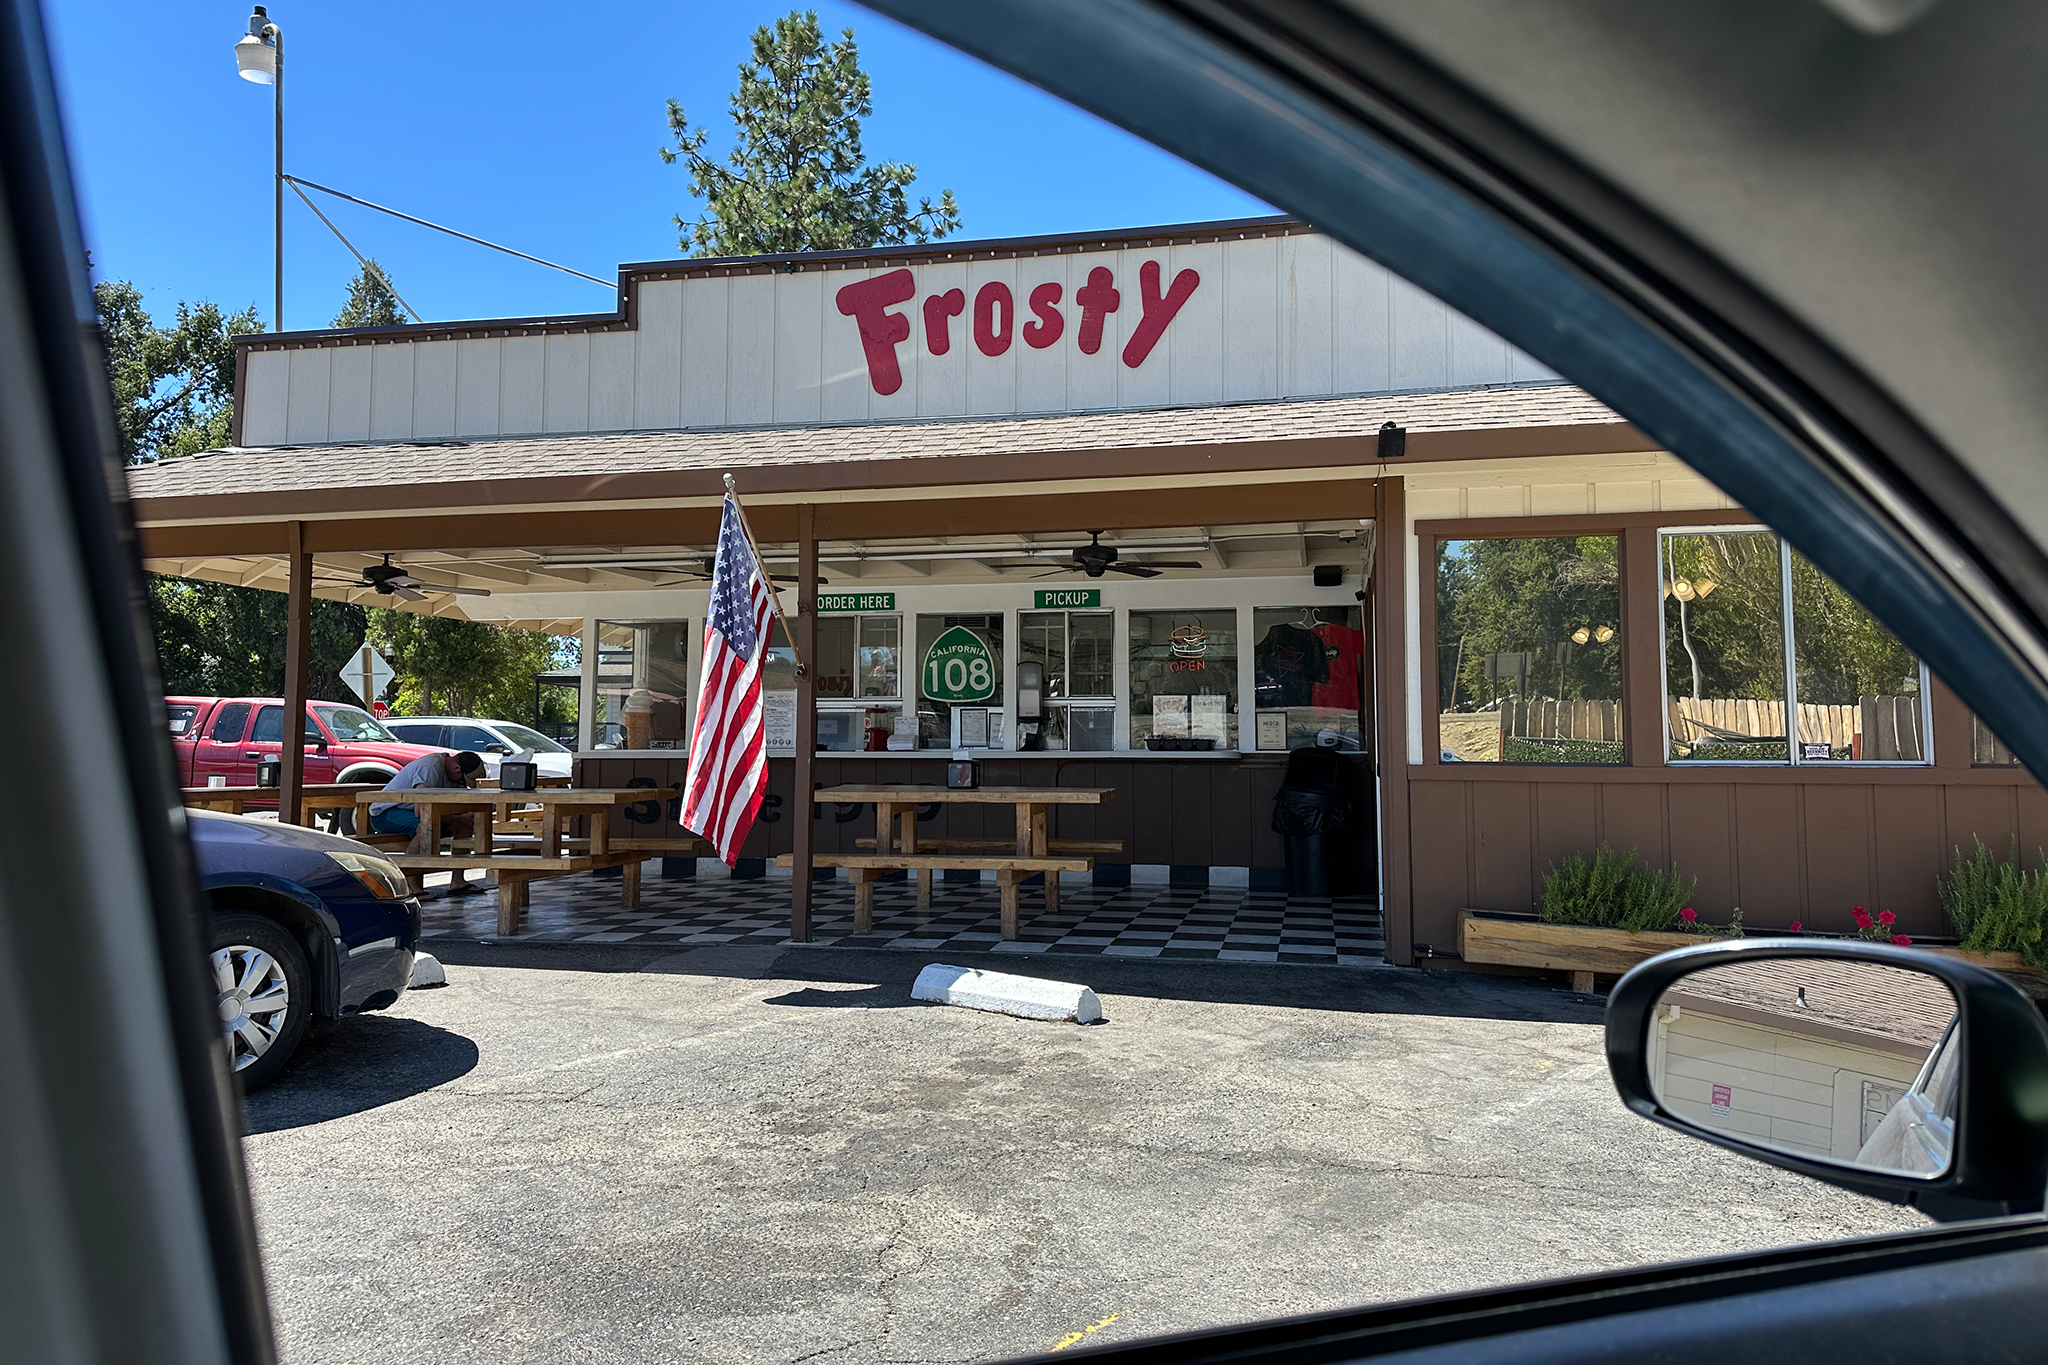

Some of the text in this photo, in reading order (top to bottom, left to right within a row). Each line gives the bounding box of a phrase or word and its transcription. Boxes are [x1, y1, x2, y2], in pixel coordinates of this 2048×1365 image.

[836, 260, 1201, 396] Frosty
[817, 595, 890, 609] ORDER HERE
[1045, 592, 1089, 605] PICKUP
[930, 645, 986, 659] CALIFORNIA
[1170, 660, 1205, 672] OPEN
[929, 658, 991, 692] 108
[817, 669, 852, 696] osty
[374, 709, 389, 719] TOP
